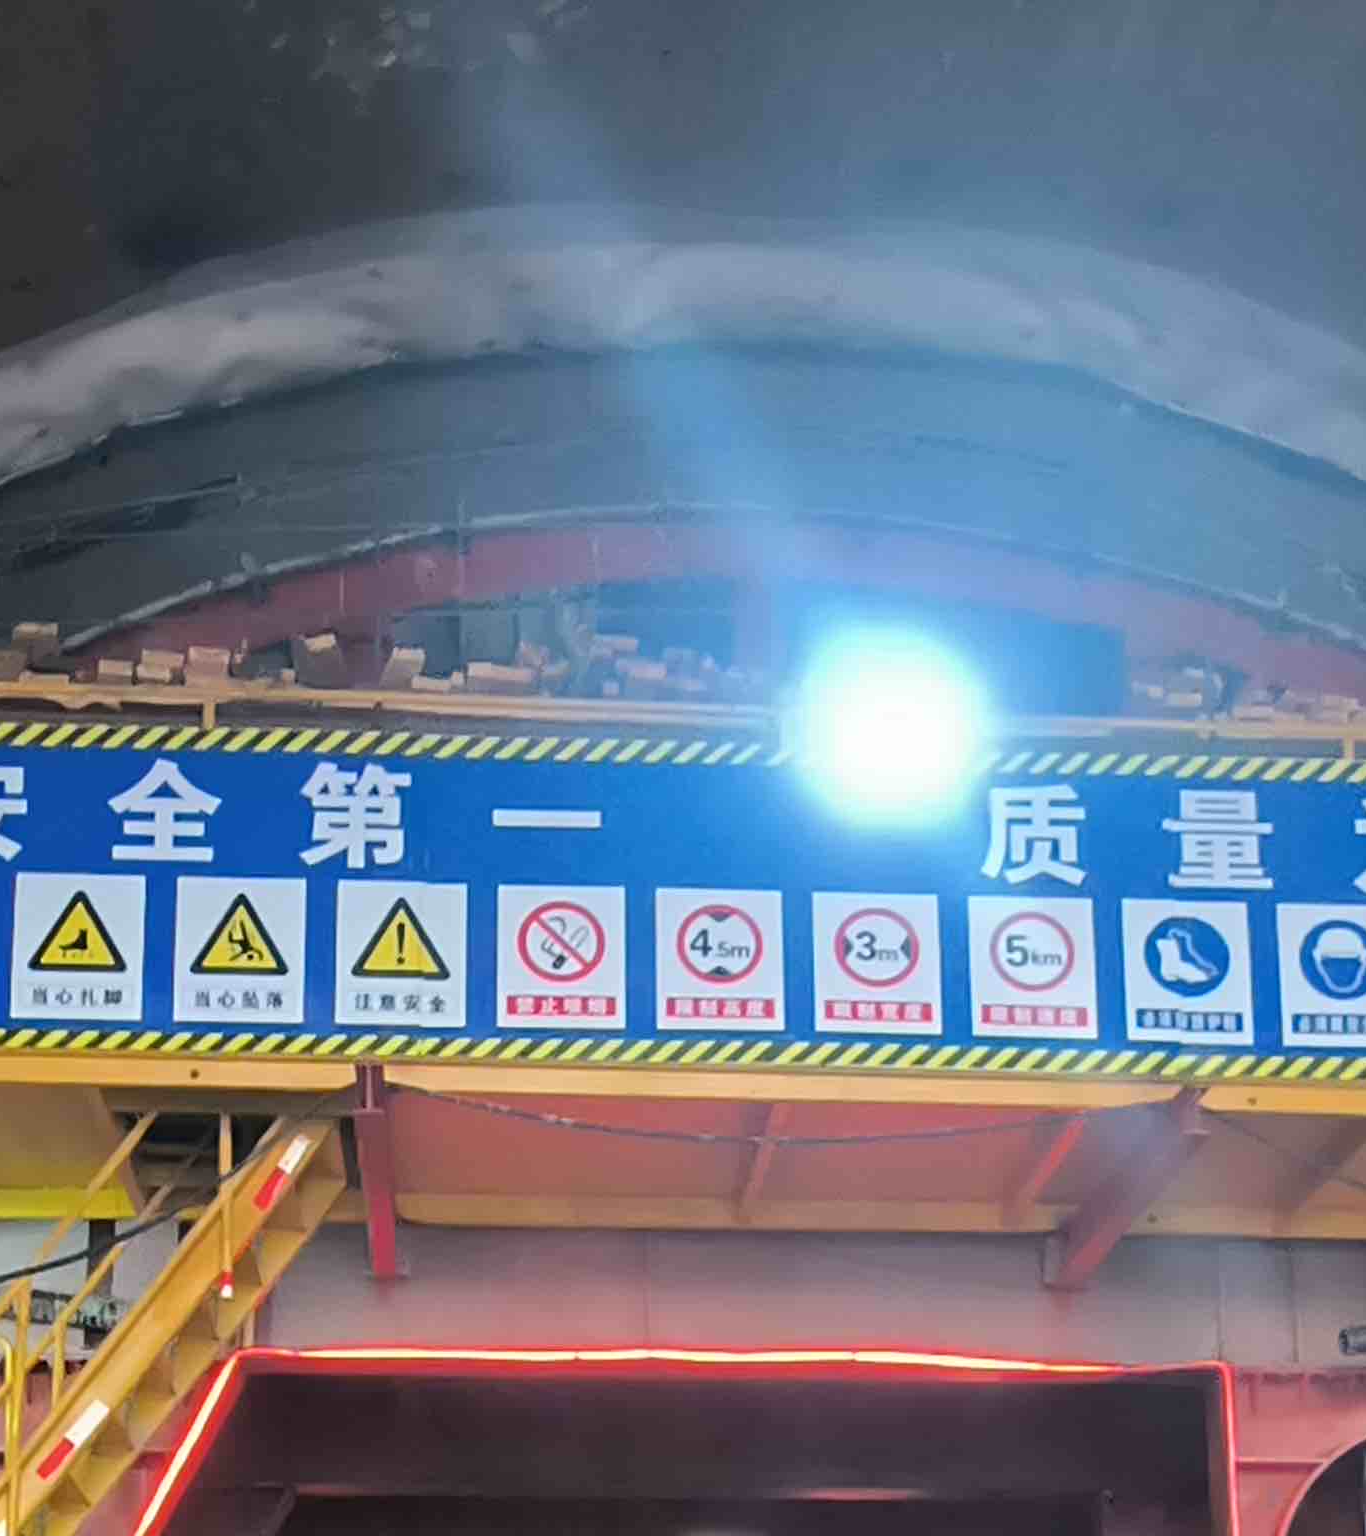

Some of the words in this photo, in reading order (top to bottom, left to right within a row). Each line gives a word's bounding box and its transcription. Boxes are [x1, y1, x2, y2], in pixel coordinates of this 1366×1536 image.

[690, 928, 751, 960] 4.5m
[855, 930, 900, 961] 3m
[1005, 935, 1063, 967] 5km
[32, 988, 123, 1006] 当心扎脚
[194, 991, 285, 1009] 当心坠落
[354, 993, 446, 1013] 注意安全
